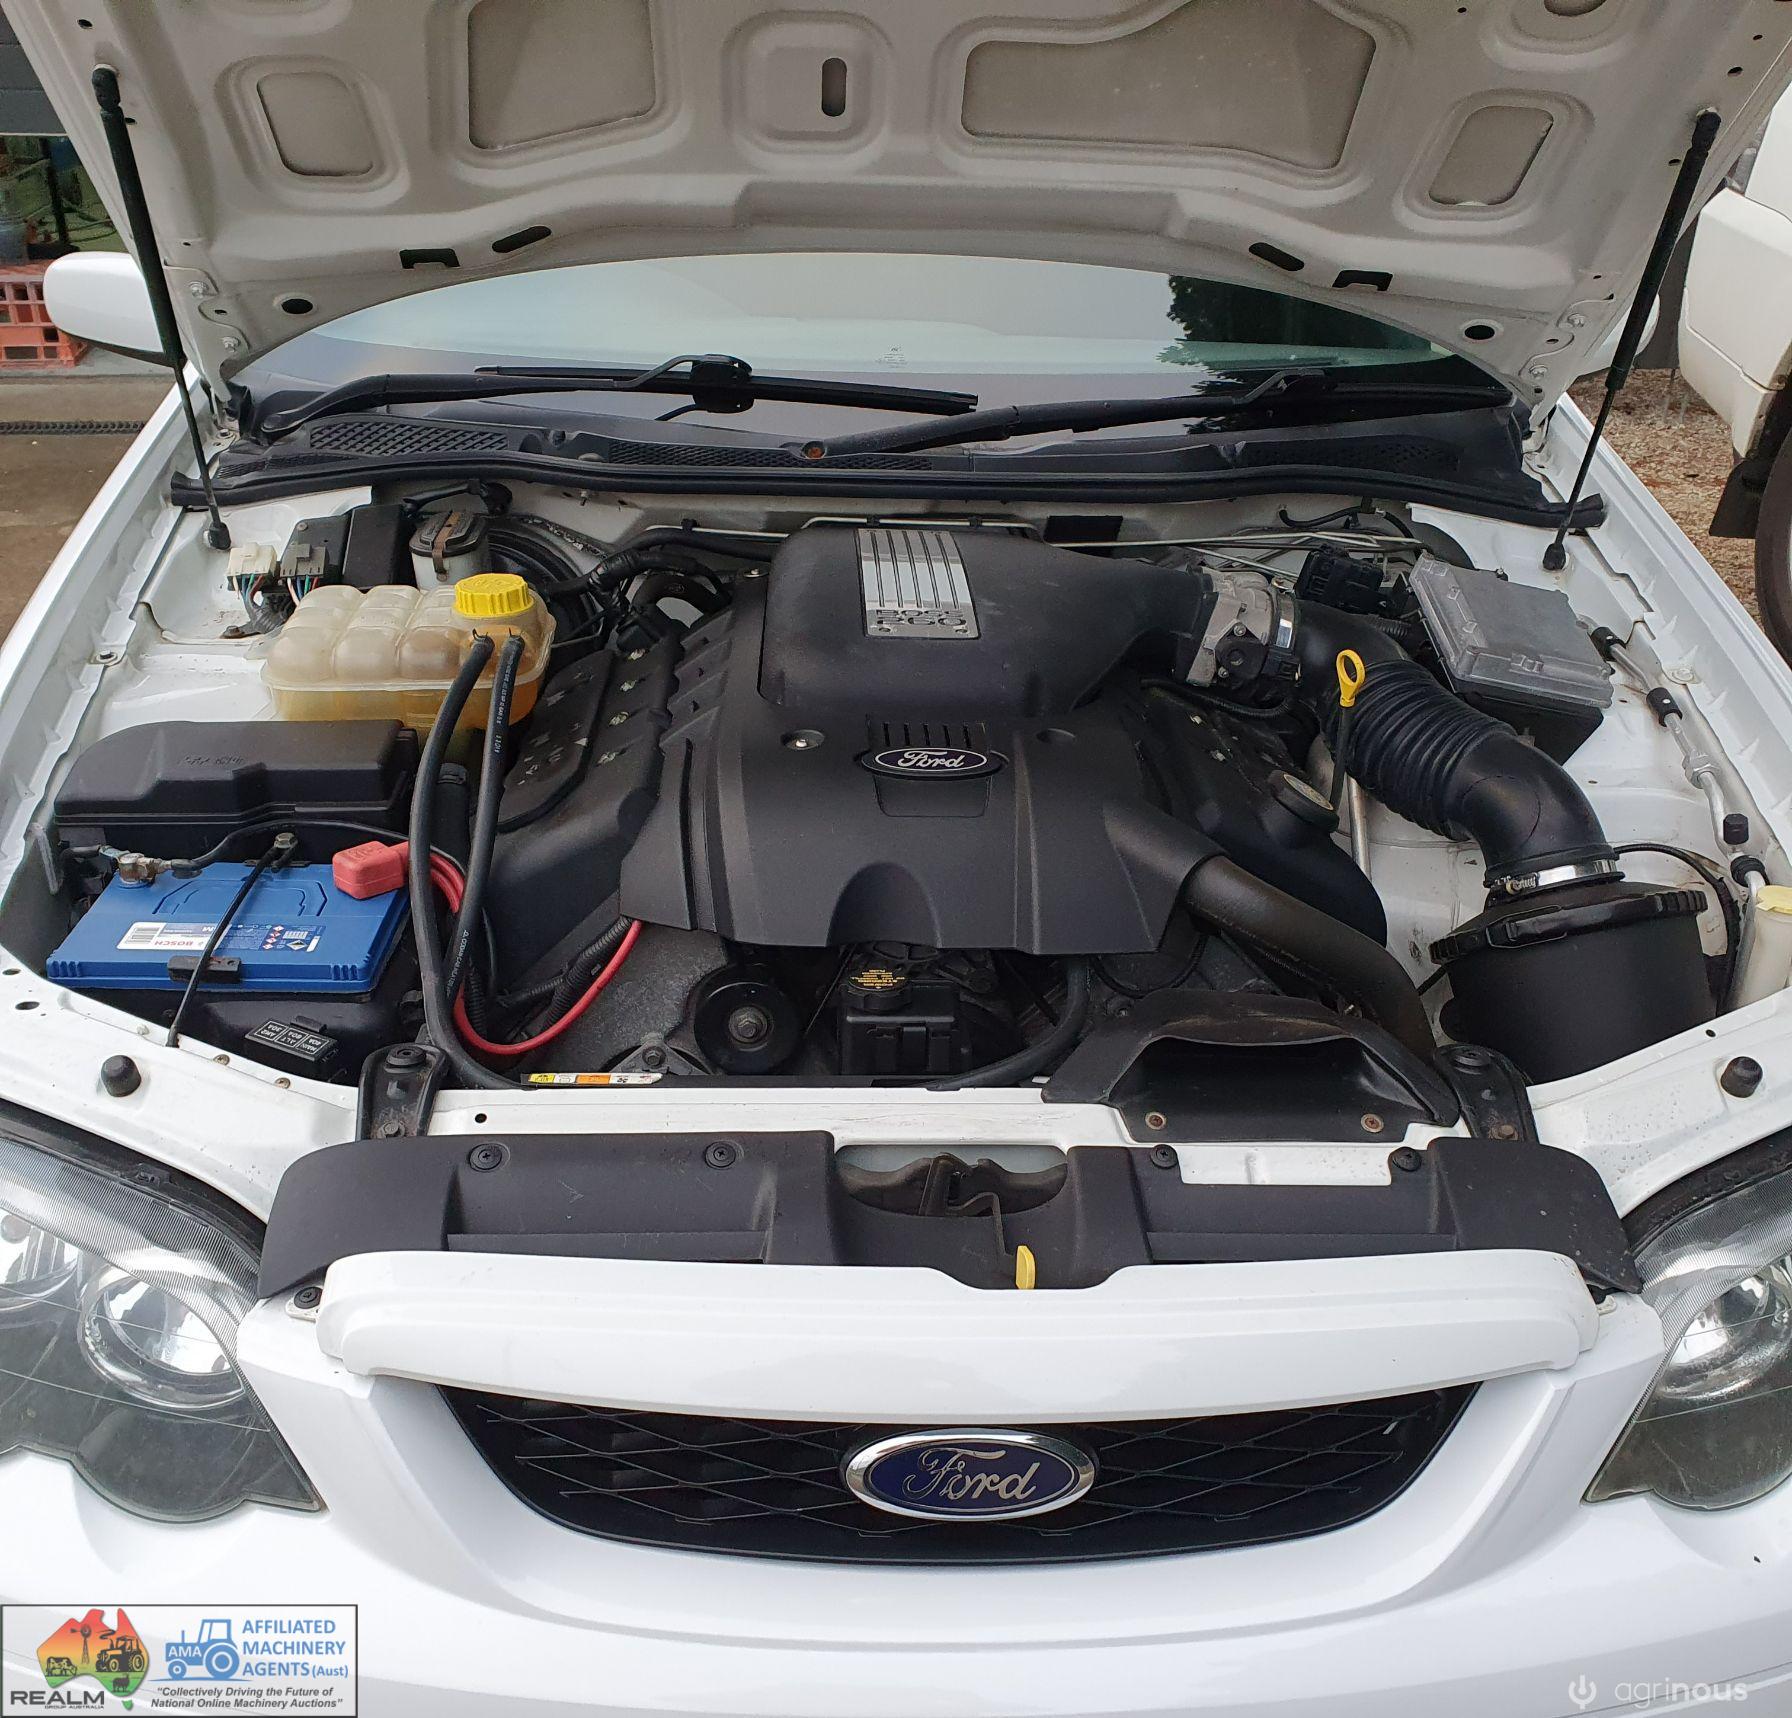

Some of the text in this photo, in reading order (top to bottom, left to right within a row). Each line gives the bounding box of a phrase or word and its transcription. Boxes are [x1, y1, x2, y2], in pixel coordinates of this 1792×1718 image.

[876, 609, 964, 617] BOSS
[897, 750, 966, 767] Ford
[301, 1043, 317, 1051] MAIN
[902, 1447, 1040, 1500] Ford
